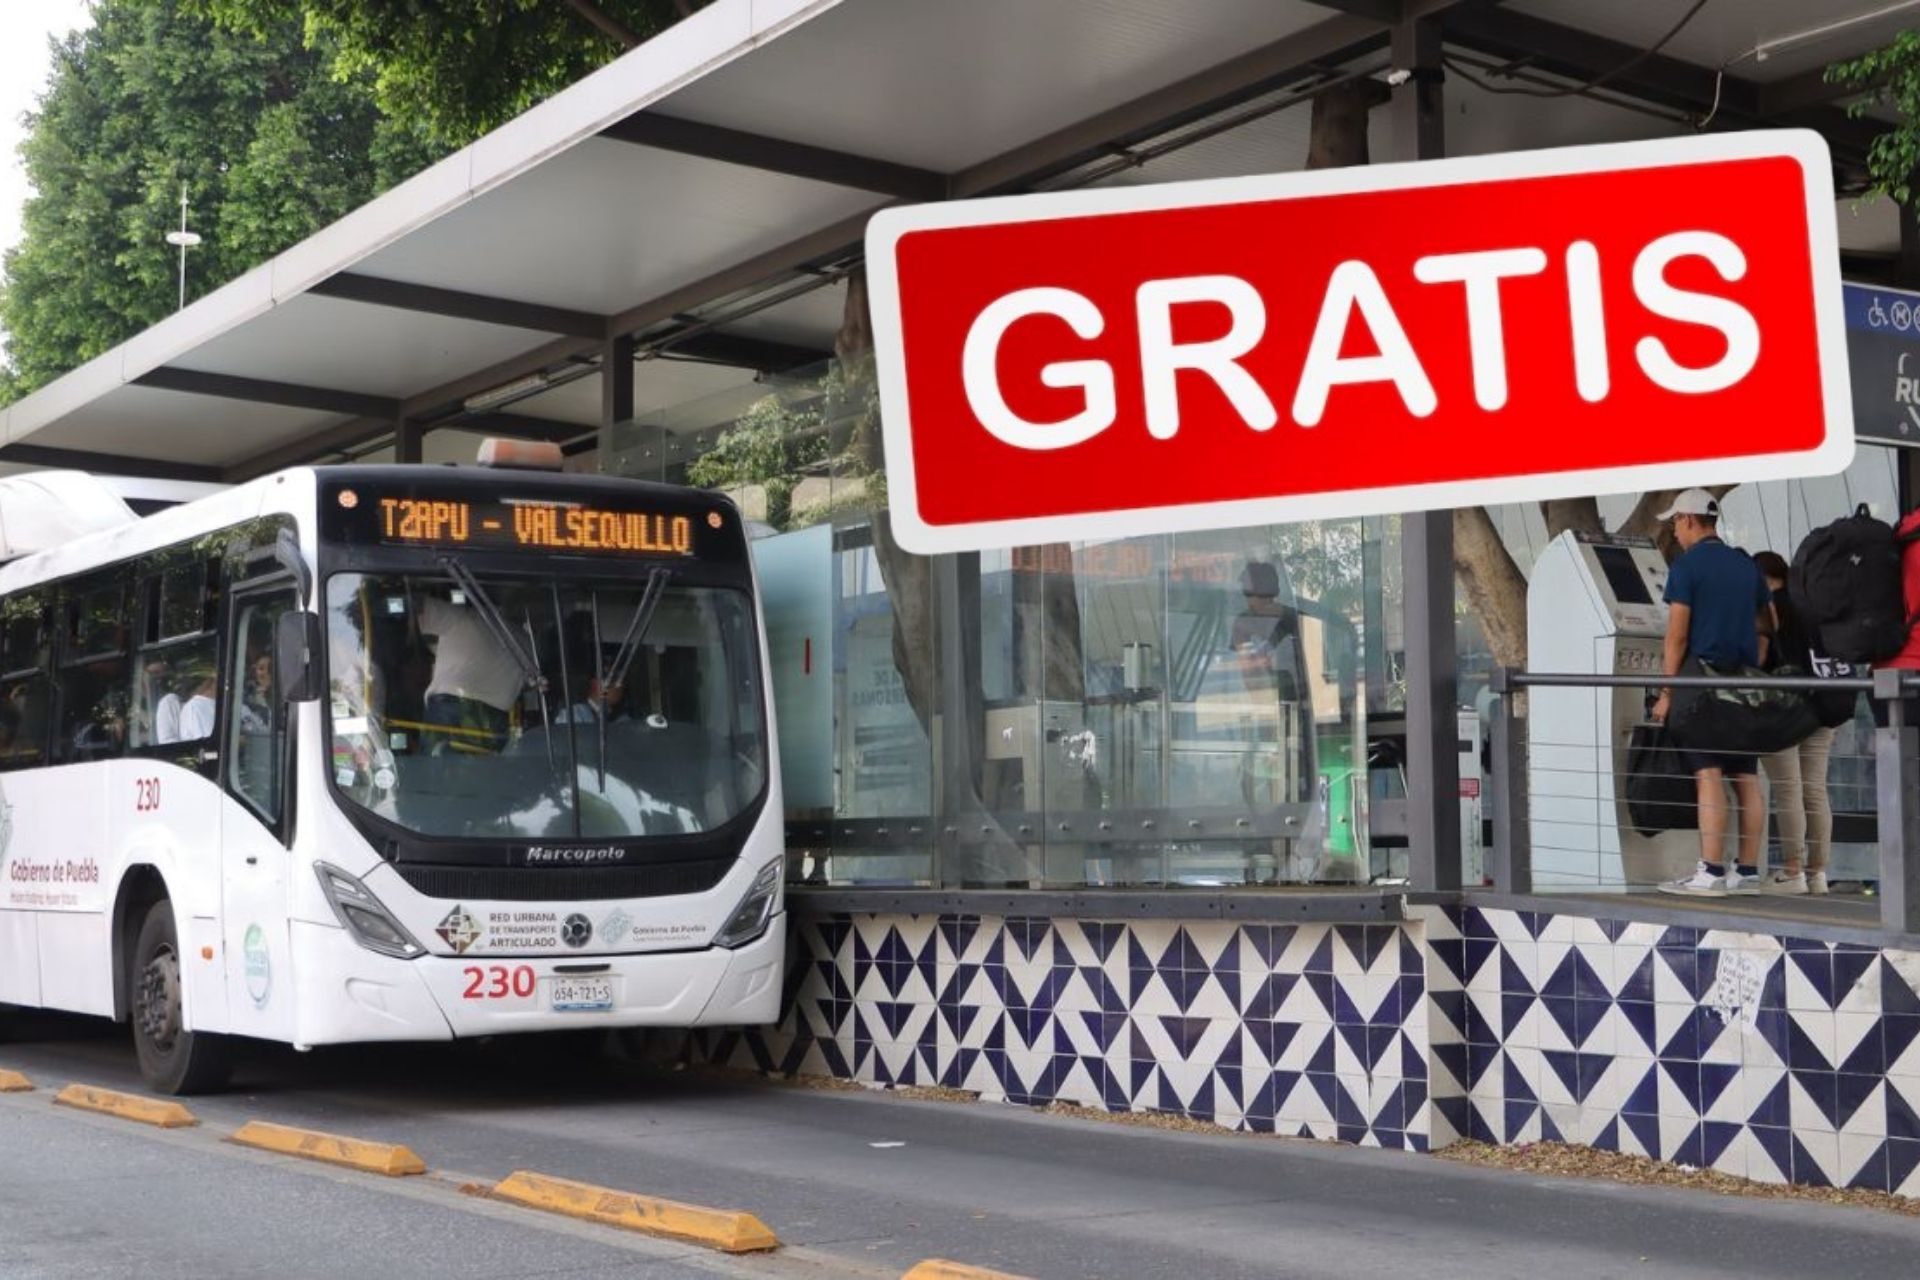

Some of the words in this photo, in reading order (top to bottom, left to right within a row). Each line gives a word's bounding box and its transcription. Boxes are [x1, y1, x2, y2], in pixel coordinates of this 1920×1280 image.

[381, 499, 469, 540] T2APU
[514, 502, 691, 554] VALSEQUILLO
[136, 777, 160, 810] 230
[526, 846, 625, 862] Marcopolo
[11, 858, 50, 882] Gobierno
[53, 859, 64, 882] de
[66, 857, 99, 883] Puebla
[489, 912, 511, 922] RED
[514, 912, 557, 922] URBANA
[489, 925, 500, 934] DE
[503, 925, 557, 934] TRANSPORTE
[489, 937, 556, 947] ARTICULADO
[463, 965, 535, 999] 230
